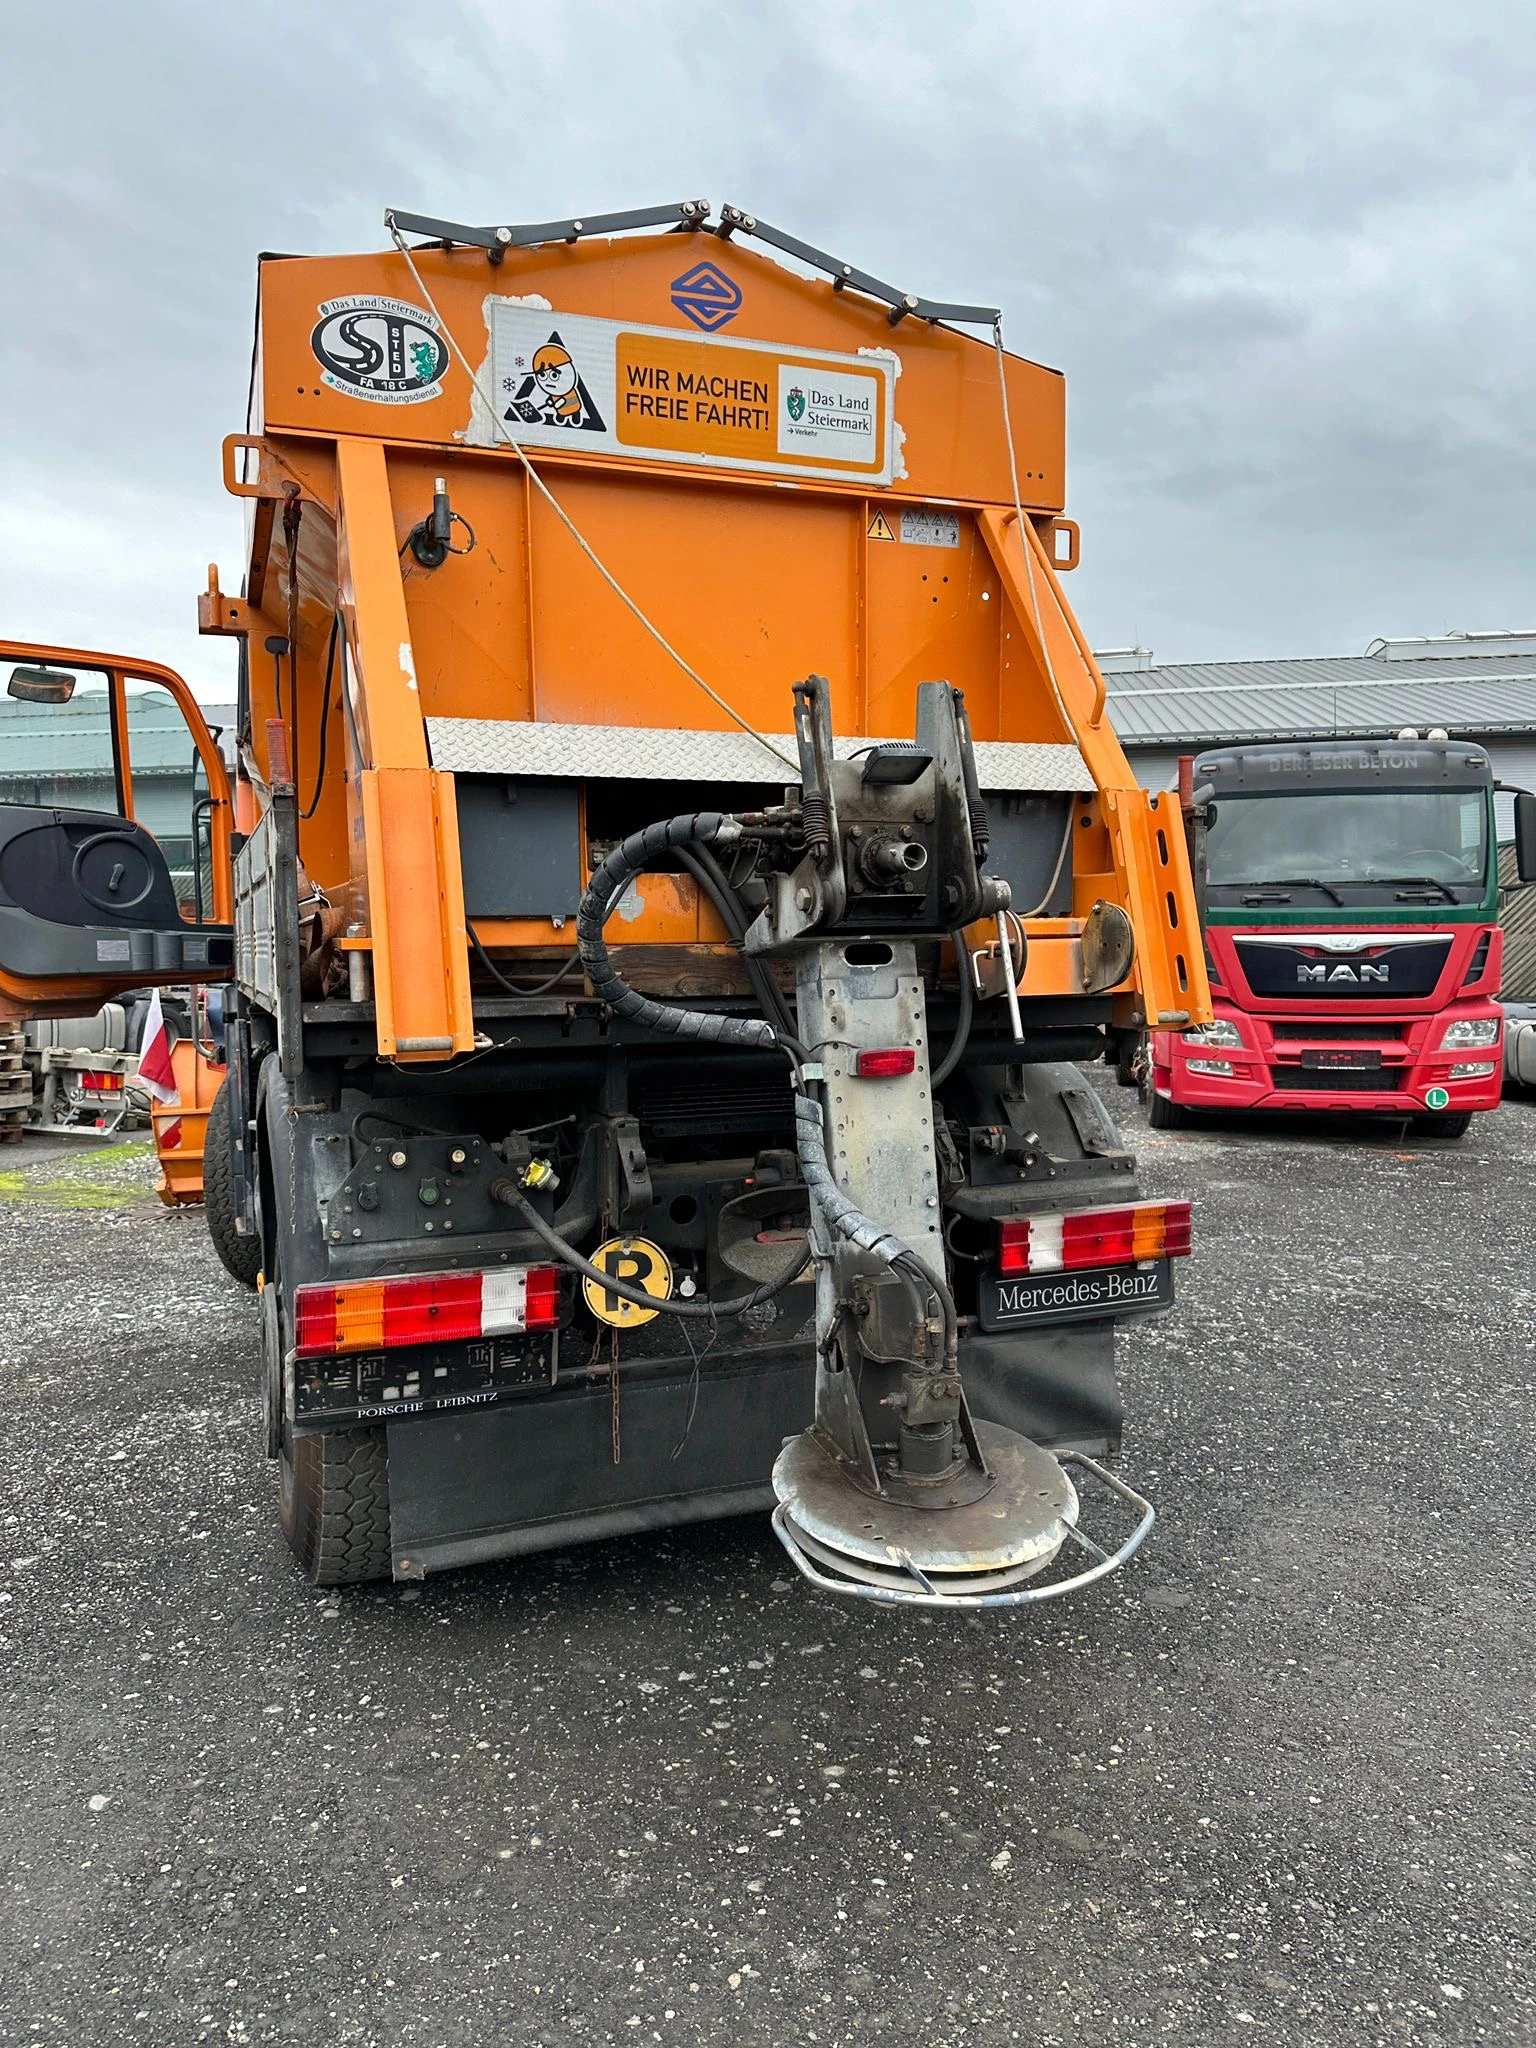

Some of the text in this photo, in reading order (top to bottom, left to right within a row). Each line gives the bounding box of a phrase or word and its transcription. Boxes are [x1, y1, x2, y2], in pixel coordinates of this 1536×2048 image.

[331, 298, 432, 326] Das Land Steiermark
[335, 380, 438, 403] Straßenerhaltungsdienst
[360, 377, 407, 390] FA 18 C
[626, 364, 768, 404] WIR MACHEN
[811, 390, 869, 411] Das Land
[626, 393, 769, 431] FREIE FAHRT!
[808, 411, 870, 432] Steiermark
[795, 428, 818, 437] Verkehr
[1359, 755, 1418, 770] BETON
[1296, 964, 1389, 982] MAN
[1433, 1091, 1443, 1105] L
[605, 1250, 656, 1312] R
[998, 1273, 1158, 1312] Mercedes-Benz
[357, 1392, 498, 1419] PORSCHE LEIBNITZ
